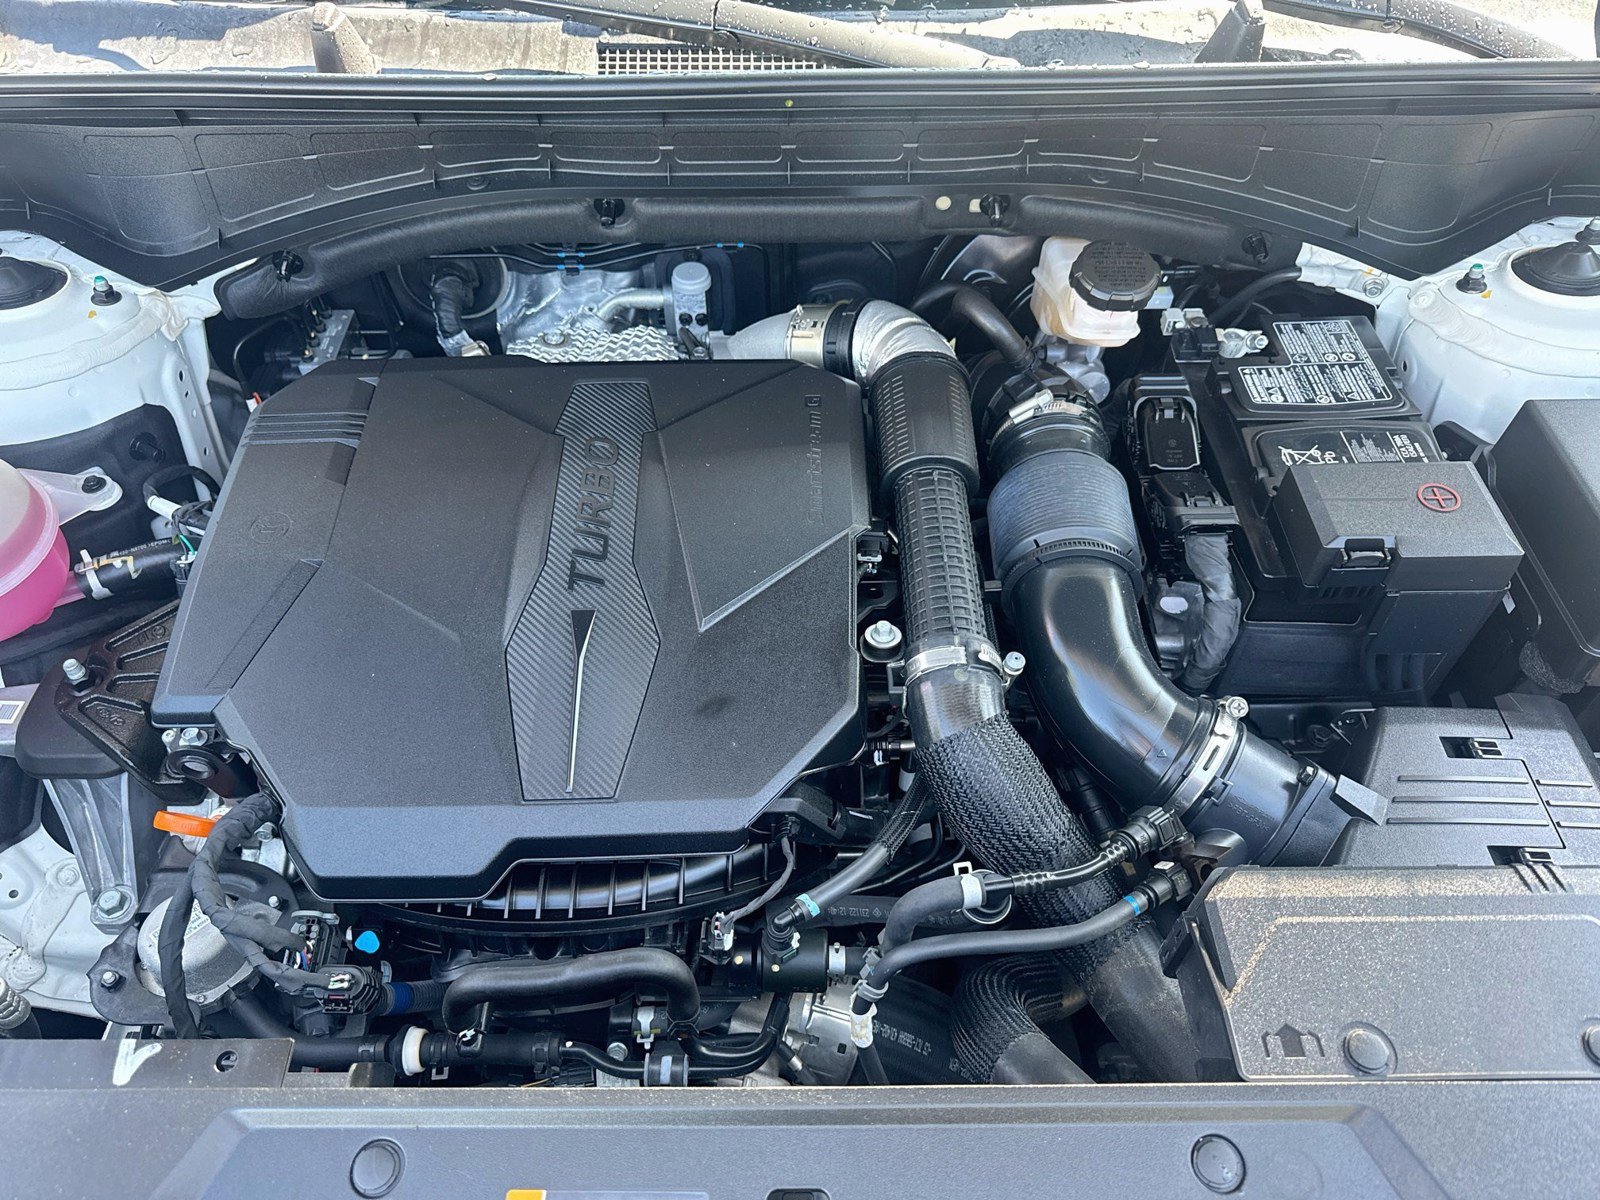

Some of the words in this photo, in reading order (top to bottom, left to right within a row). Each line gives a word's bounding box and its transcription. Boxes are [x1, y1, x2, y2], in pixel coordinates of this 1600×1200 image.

[566, 436, 619, 592] TURBO
[805, 409, 825, 527] Smartstream
[1324, 450, 1339, 464] Pb
